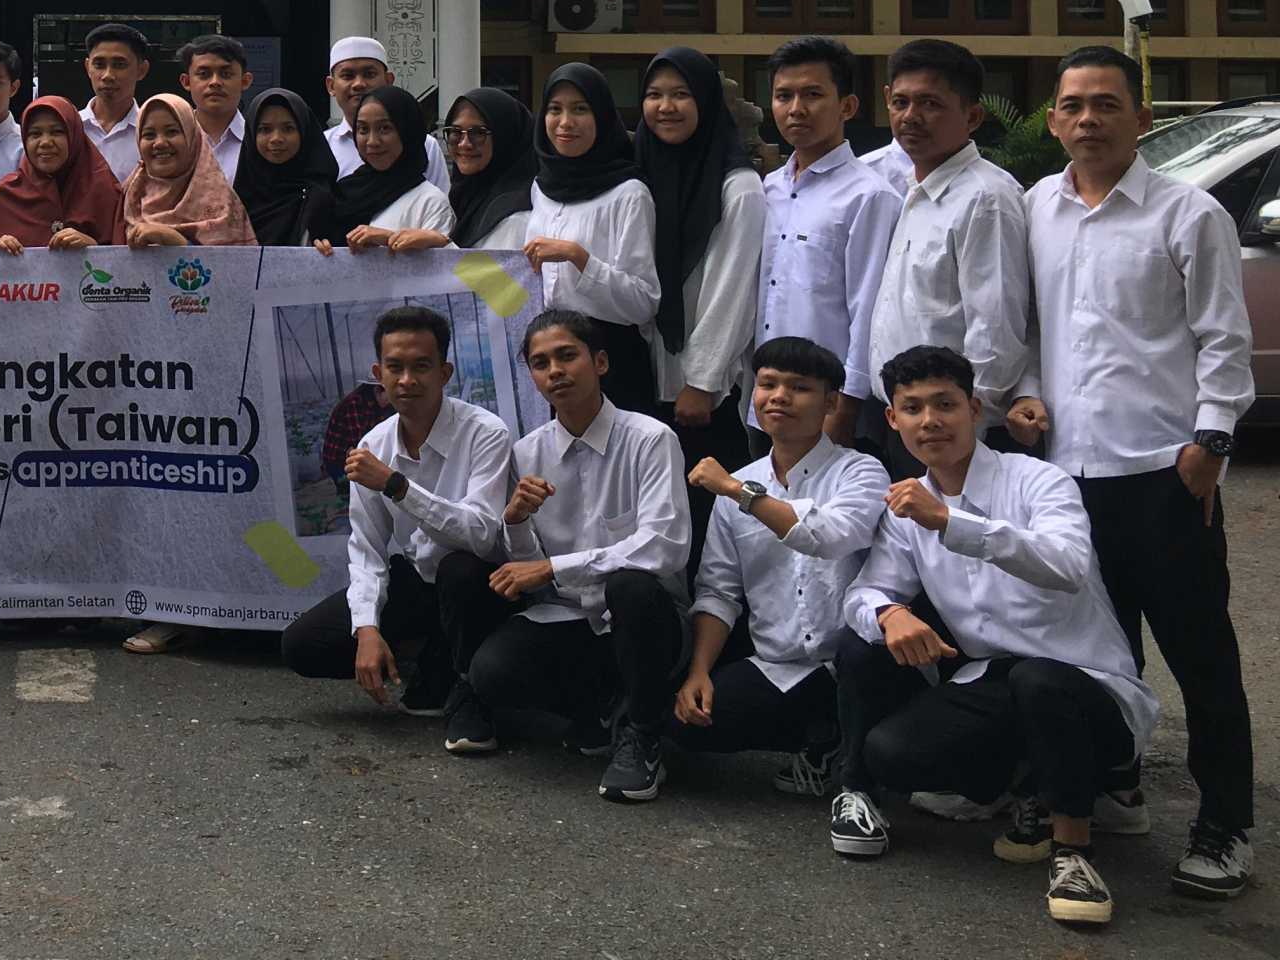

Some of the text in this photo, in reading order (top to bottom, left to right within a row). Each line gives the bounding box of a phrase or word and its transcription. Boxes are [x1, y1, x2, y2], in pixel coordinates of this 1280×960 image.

[48, 394, 260, 456] (Taiwan)
[17, 455, 247, 495] apprenticeship
[68, 595, 115, 608] Selatan
